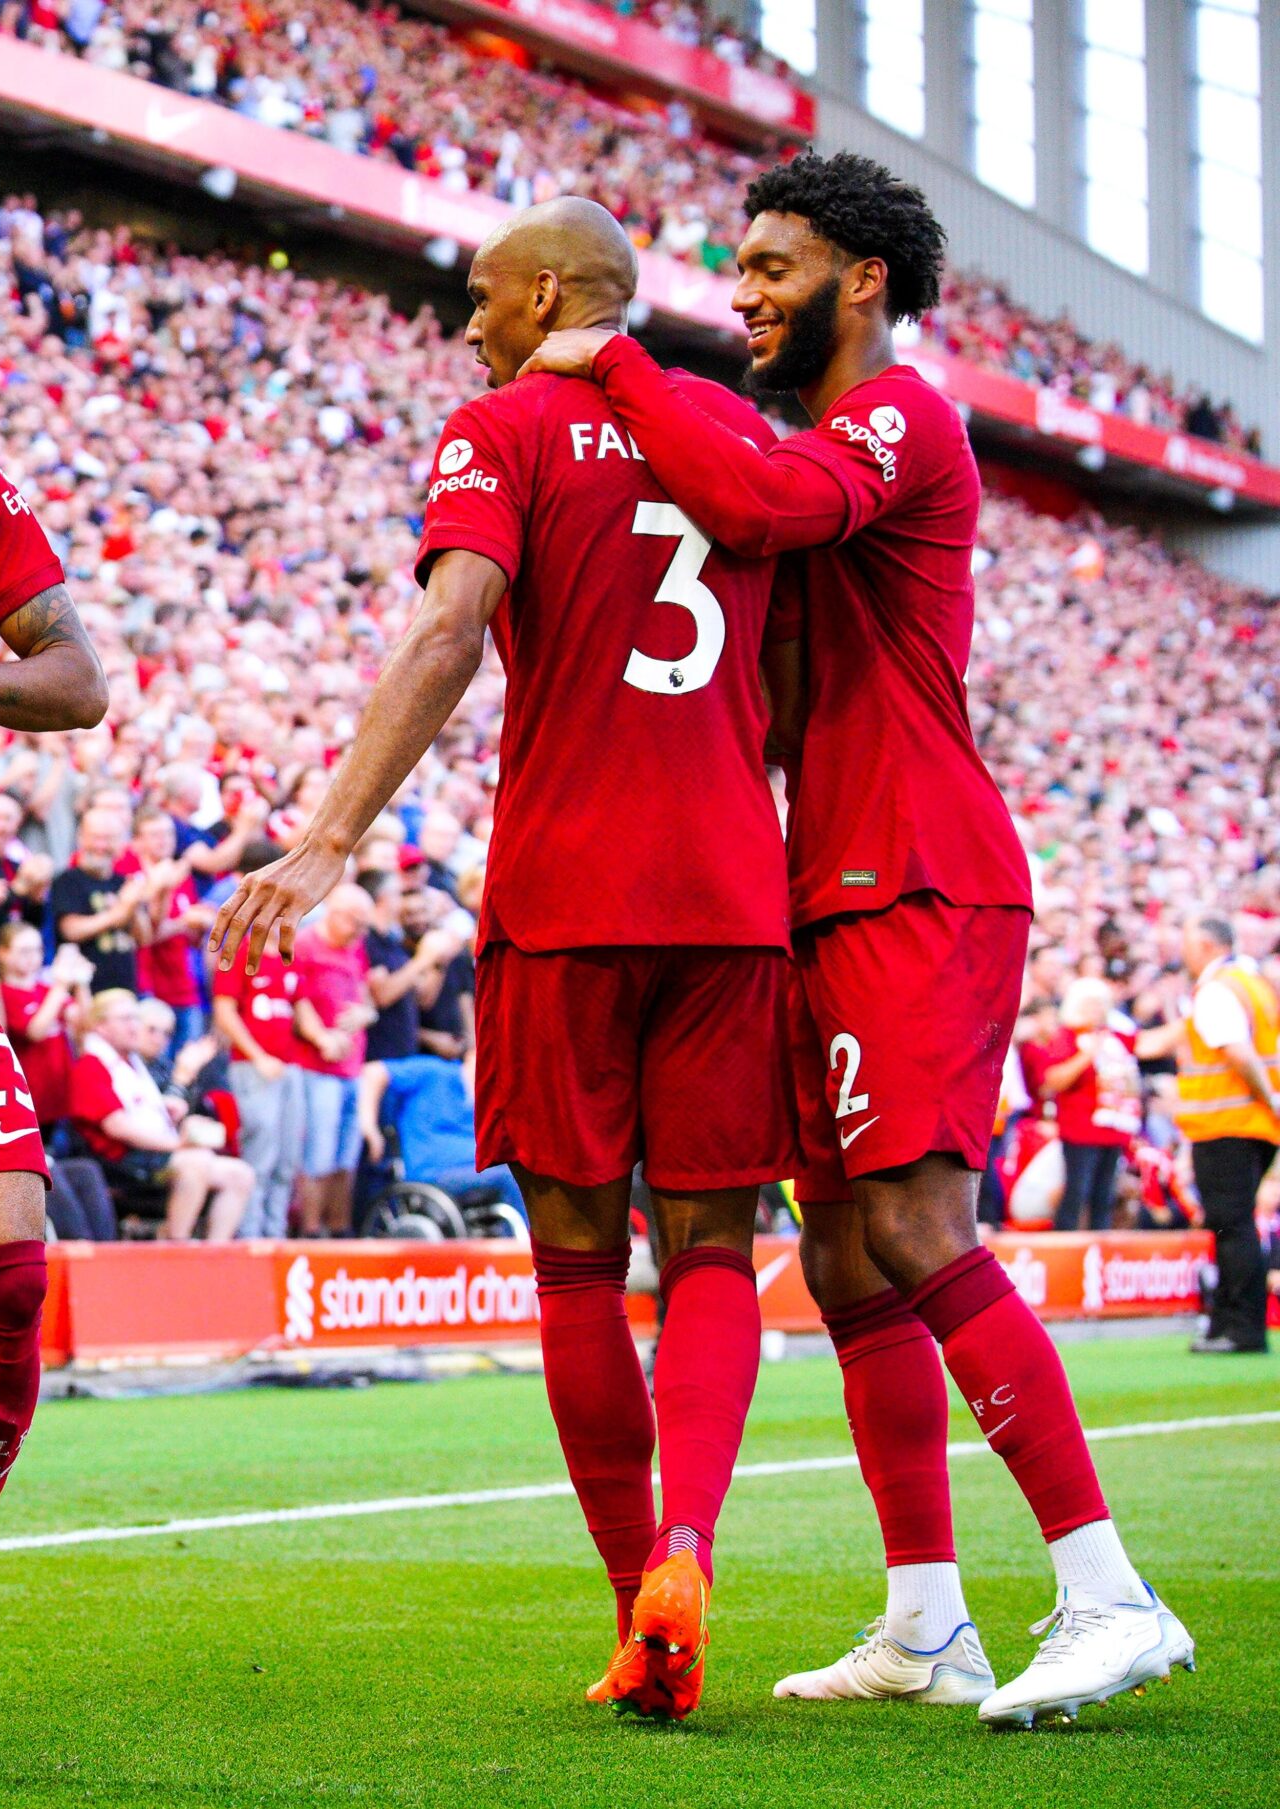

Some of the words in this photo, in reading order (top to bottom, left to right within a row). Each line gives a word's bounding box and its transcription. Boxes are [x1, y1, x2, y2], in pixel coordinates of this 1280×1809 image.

[830, 416, 897, 483] Expedia
[427, 468, 499, 503] pedia
[622, 500, 726, 695] 3
[829, 1032, 870, 1119] 2
[320, 1265, 468, 1330] standard
[468, 1264, 542, 1324] char
